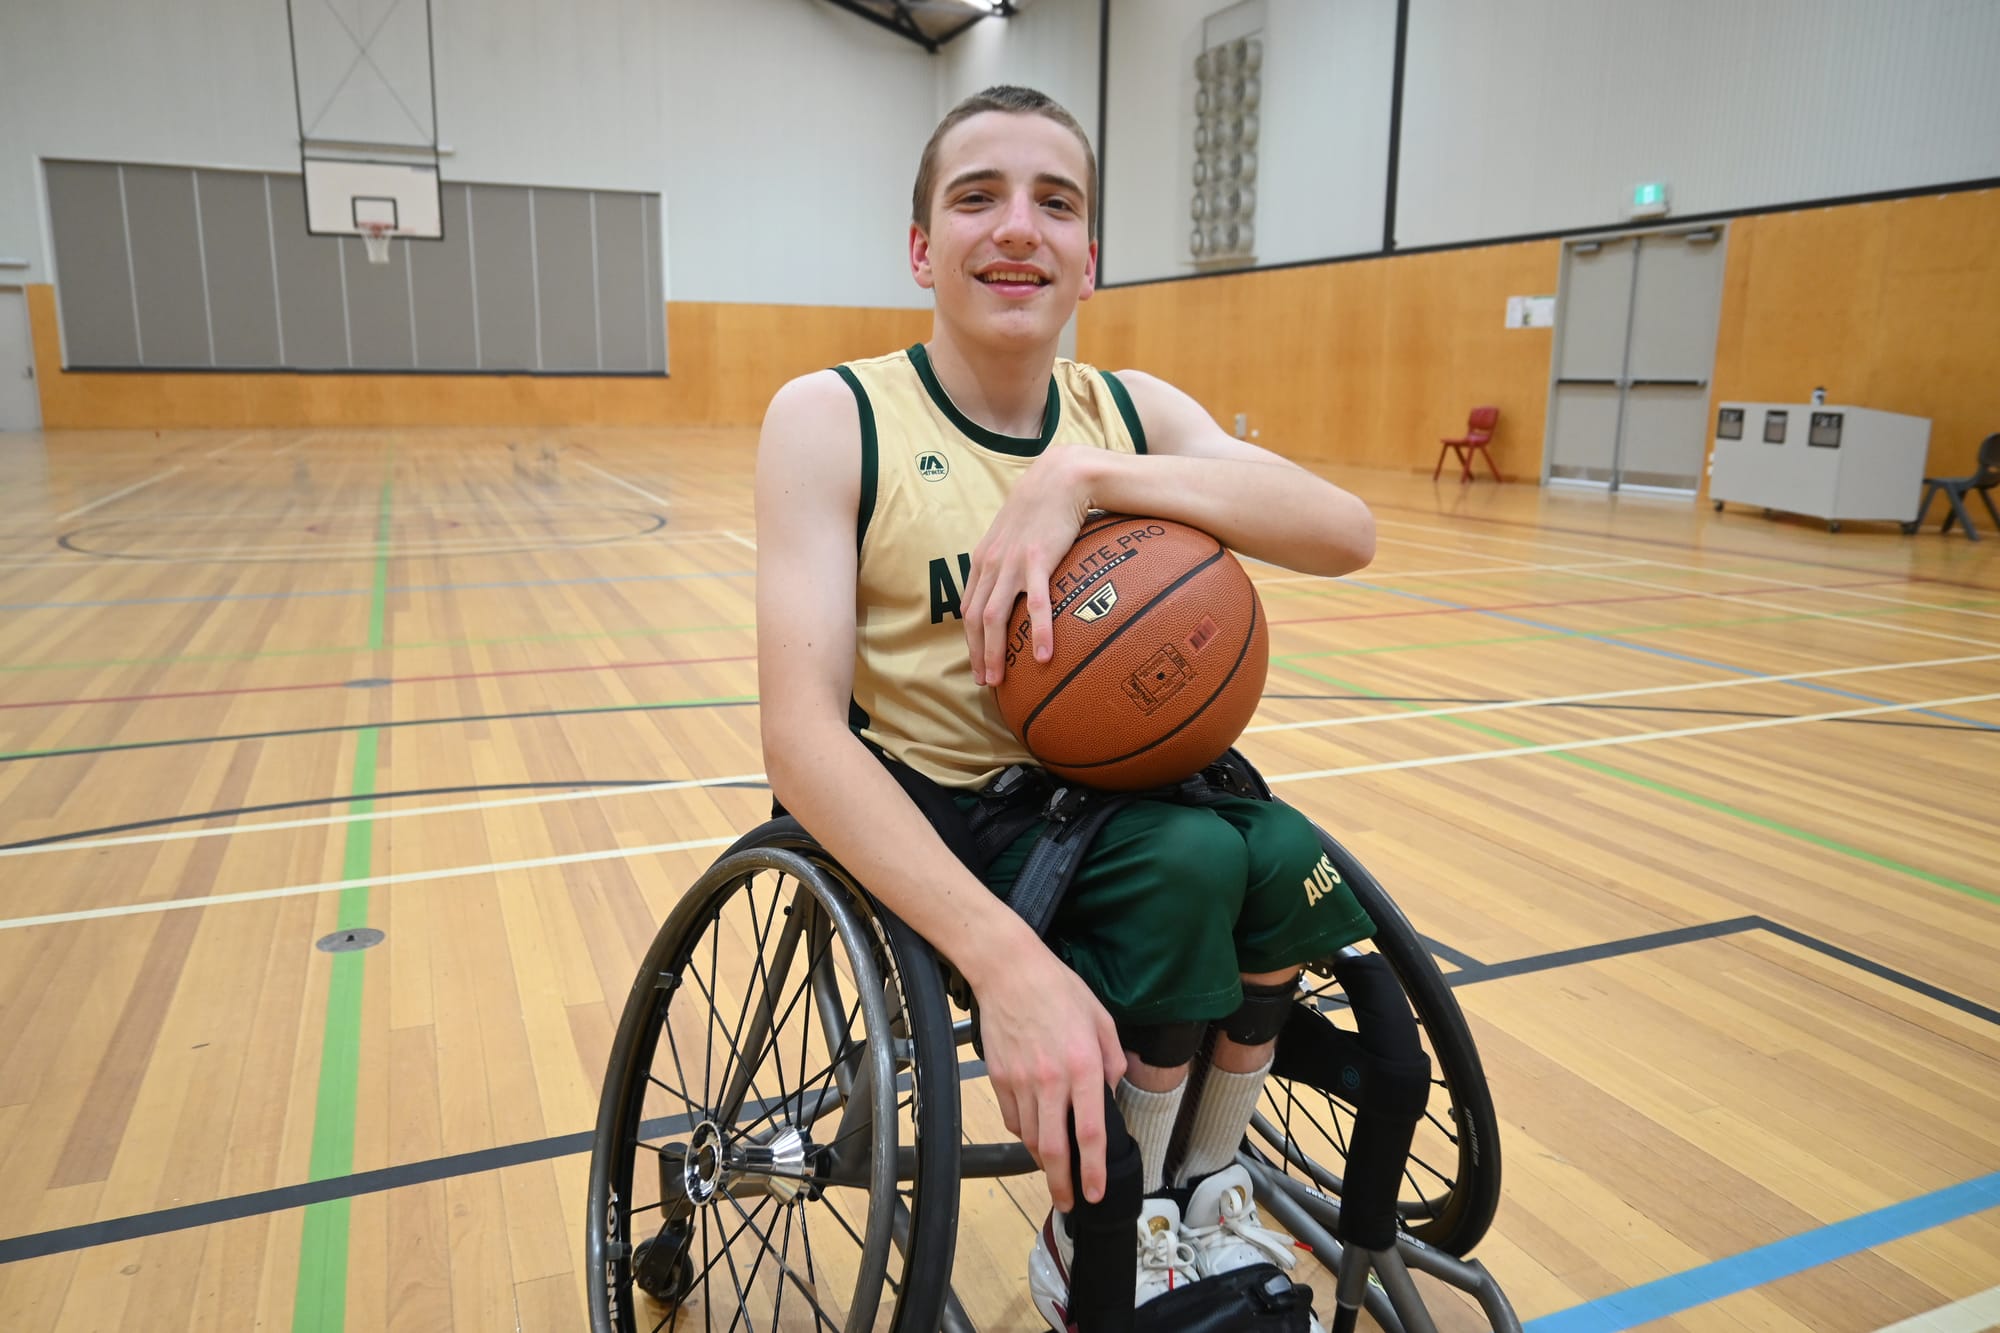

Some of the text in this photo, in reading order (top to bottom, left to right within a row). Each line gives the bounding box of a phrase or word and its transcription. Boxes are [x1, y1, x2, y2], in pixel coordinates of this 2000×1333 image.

[1056, 545, 1118, 594] FLITE
[1116, 525, 1165, 549] PRO
[1088, 555, 1126, 582] LEATHER
[1304, 852, 1341, 907] AUS
